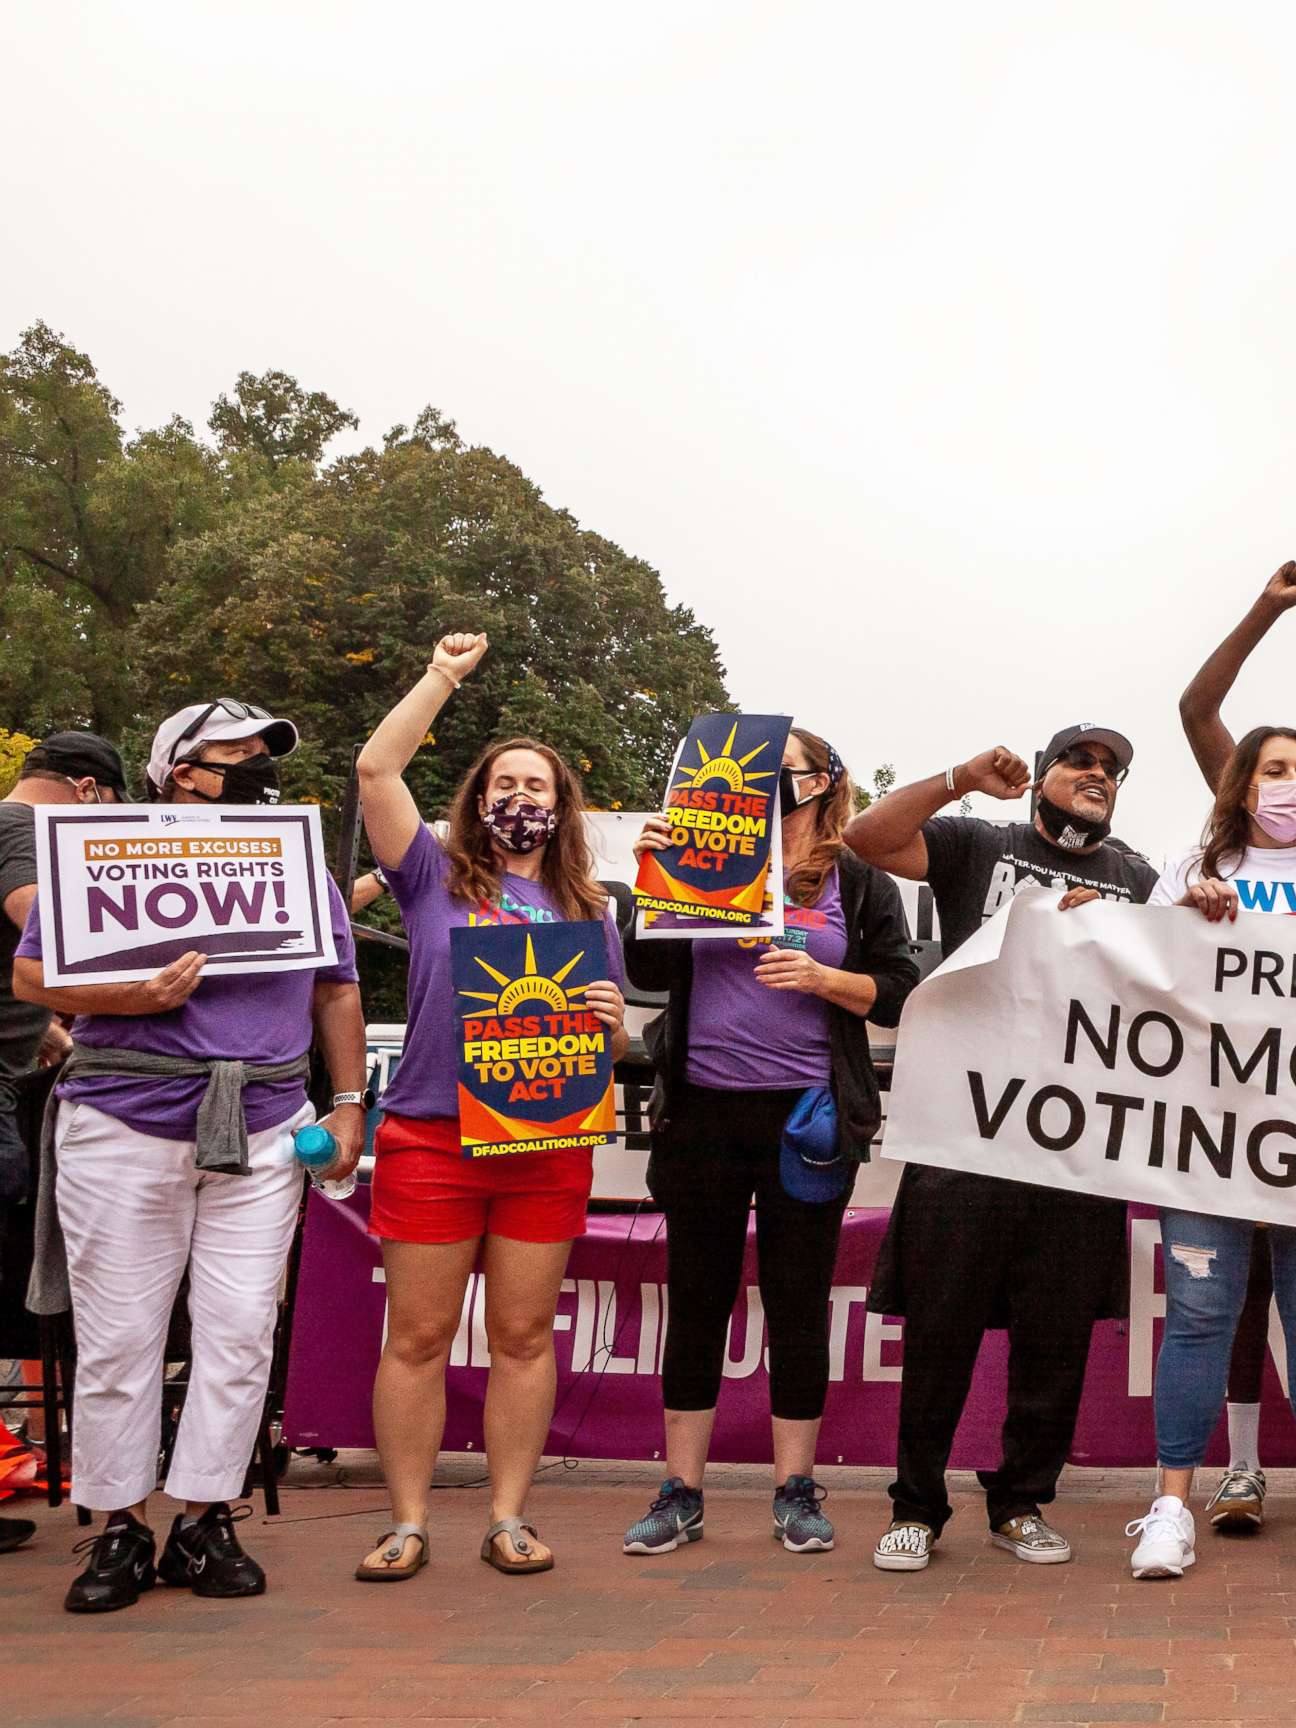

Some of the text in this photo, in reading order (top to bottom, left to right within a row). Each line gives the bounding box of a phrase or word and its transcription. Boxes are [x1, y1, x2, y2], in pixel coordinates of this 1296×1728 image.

[721, 793, 768, 816] THE
[89, 840, 278, 857] NO MORE EXCUSES:
[671, 826, 756, 856] O VOTE
[86, 861, 284, 881] VOTING RIGHTS
[678, 848, 729, 872] ACT
[1030, 863, 1048, 875] YOU
[1085, 878, 1099, 888] WE
[86, 880, 290, 933] NOW!
[636, 896, 752, 923] DFADCOALITION.ORG
[463, 1012, 603, 1041] PASS THE
[1064, 999, 1184, 1077] NO
[464, 1033, 605, 1063] FREEDOM
[474, 1054, 597, 1083] TO VOTE
[508, 1077, 566, 1103] ACT
[472, 1135, 608, 1158] DFADCOALITION.ORG
